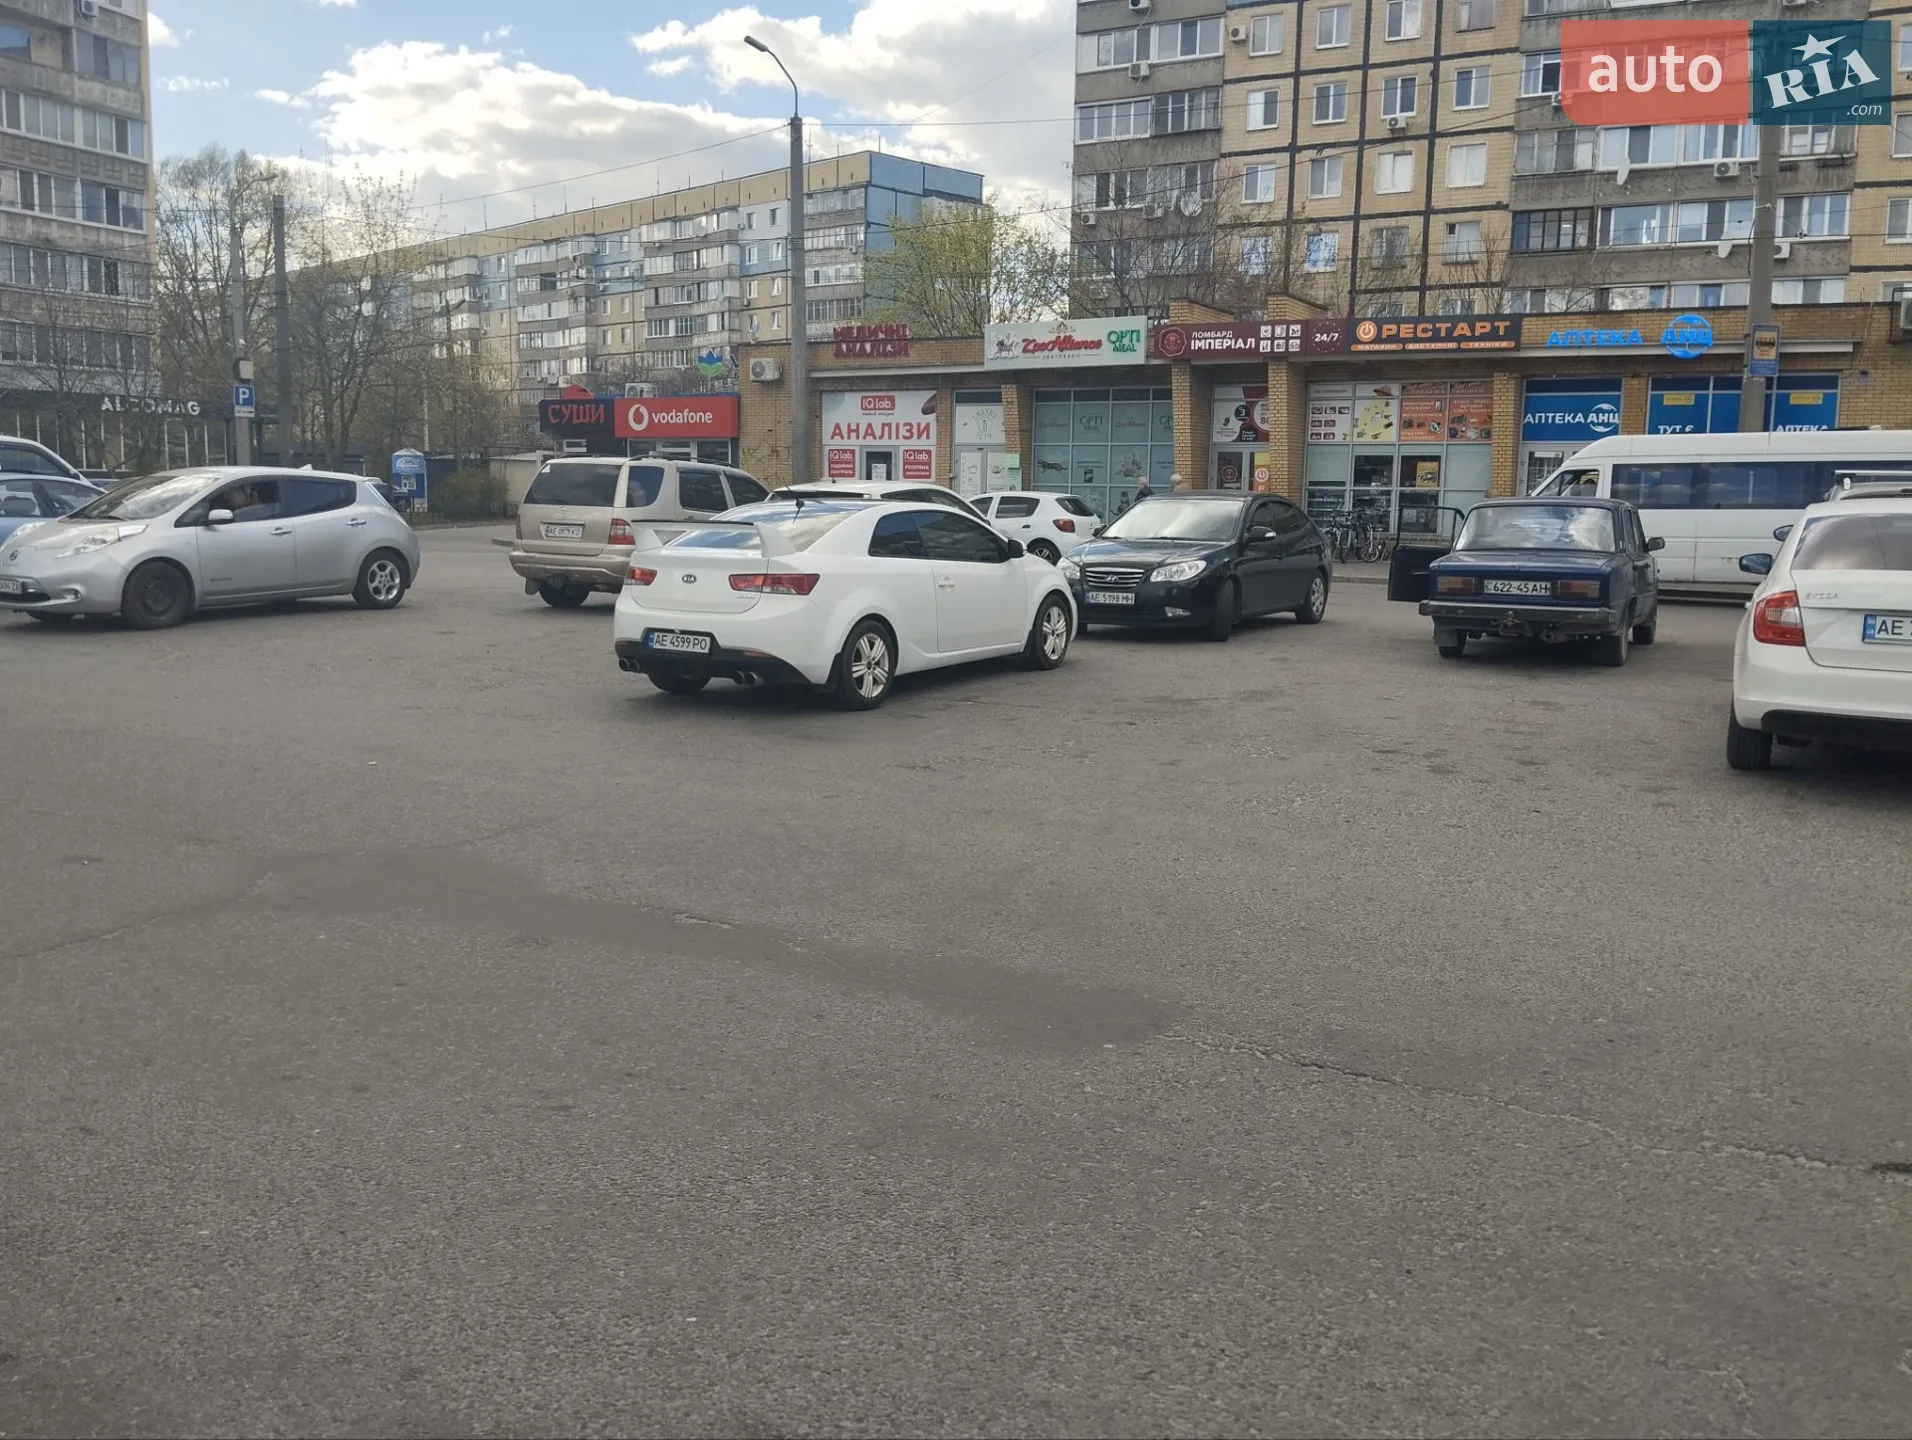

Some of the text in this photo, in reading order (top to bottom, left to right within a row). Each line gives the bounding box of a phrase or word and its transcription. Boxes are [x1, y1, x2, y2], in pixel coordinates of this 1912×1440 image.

[1107, 329, 1141, 344] OPTI
[1191, 331, 1233, 339] ЛОМБАРД
[1314, 333, 1339, 342] 24/7
[1381, 321, 1511, 339] РЕСТАРТ
[1190, 338, 1255, 350] ІМПЕРІАЛ
[1546, 328, 1714, 348] АПТЕКА АНЦ
[833, 340, 909, 357] АНАЛІЗИ
[1112, 343, 1137, 353] MEAL
[239, 387, 250, 404] P
[548, 404, 604, 425] СУШИ
[652, 408, 713, 423] vodafone
[1523, 412, 1619, 424] АПТЕКА АНЦ
[830, 422, 931, 440] АНАЛІЗИ
[1657, 425, 1682, 434] ТУТ
[1091, 593, 1100, 601] AE
[1102, 594, 1121, 602] 5198
[1877, 619, 1904, 636] AE
[654, 634, 708, 650] AE 4599 PO
